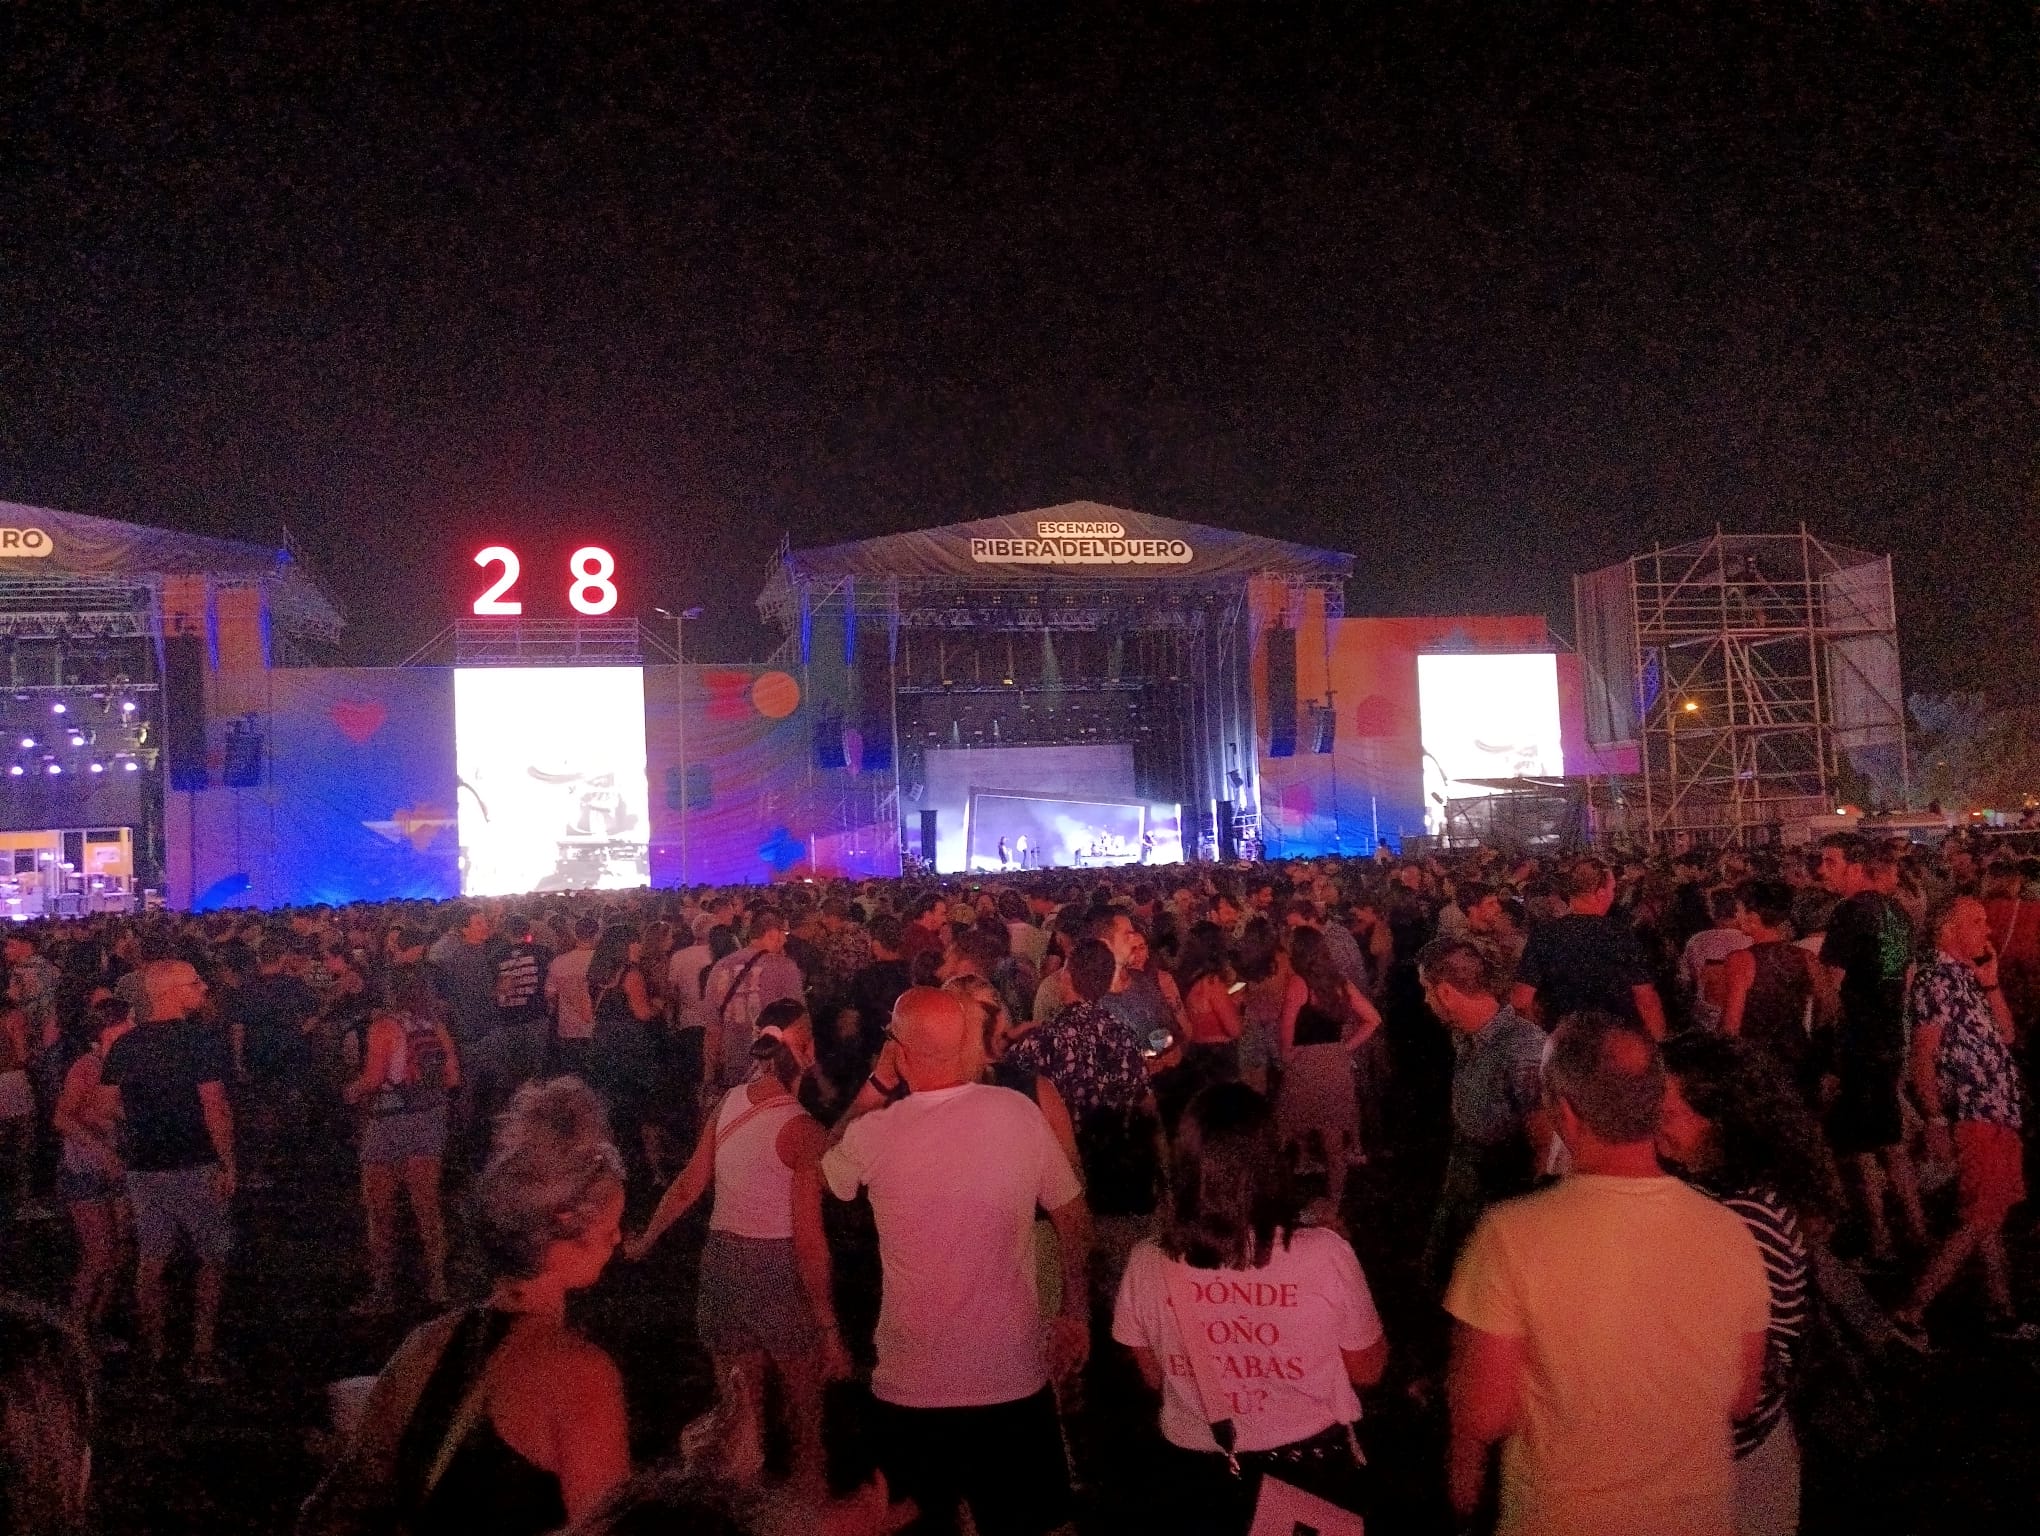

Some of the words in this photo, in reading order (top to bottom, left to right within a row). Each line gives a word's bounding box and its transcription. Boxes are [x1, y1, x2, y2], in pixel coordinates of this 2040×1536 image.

[1038, 522, 1121, 535] ESCENARIO
[973, 539, 1056, 557] RIBERA
[1061, 540, 1105, 557] DEL
[1110, 540, 1186, 558] DUERO
[1201, 1315, 1280, 1346] OÑO
